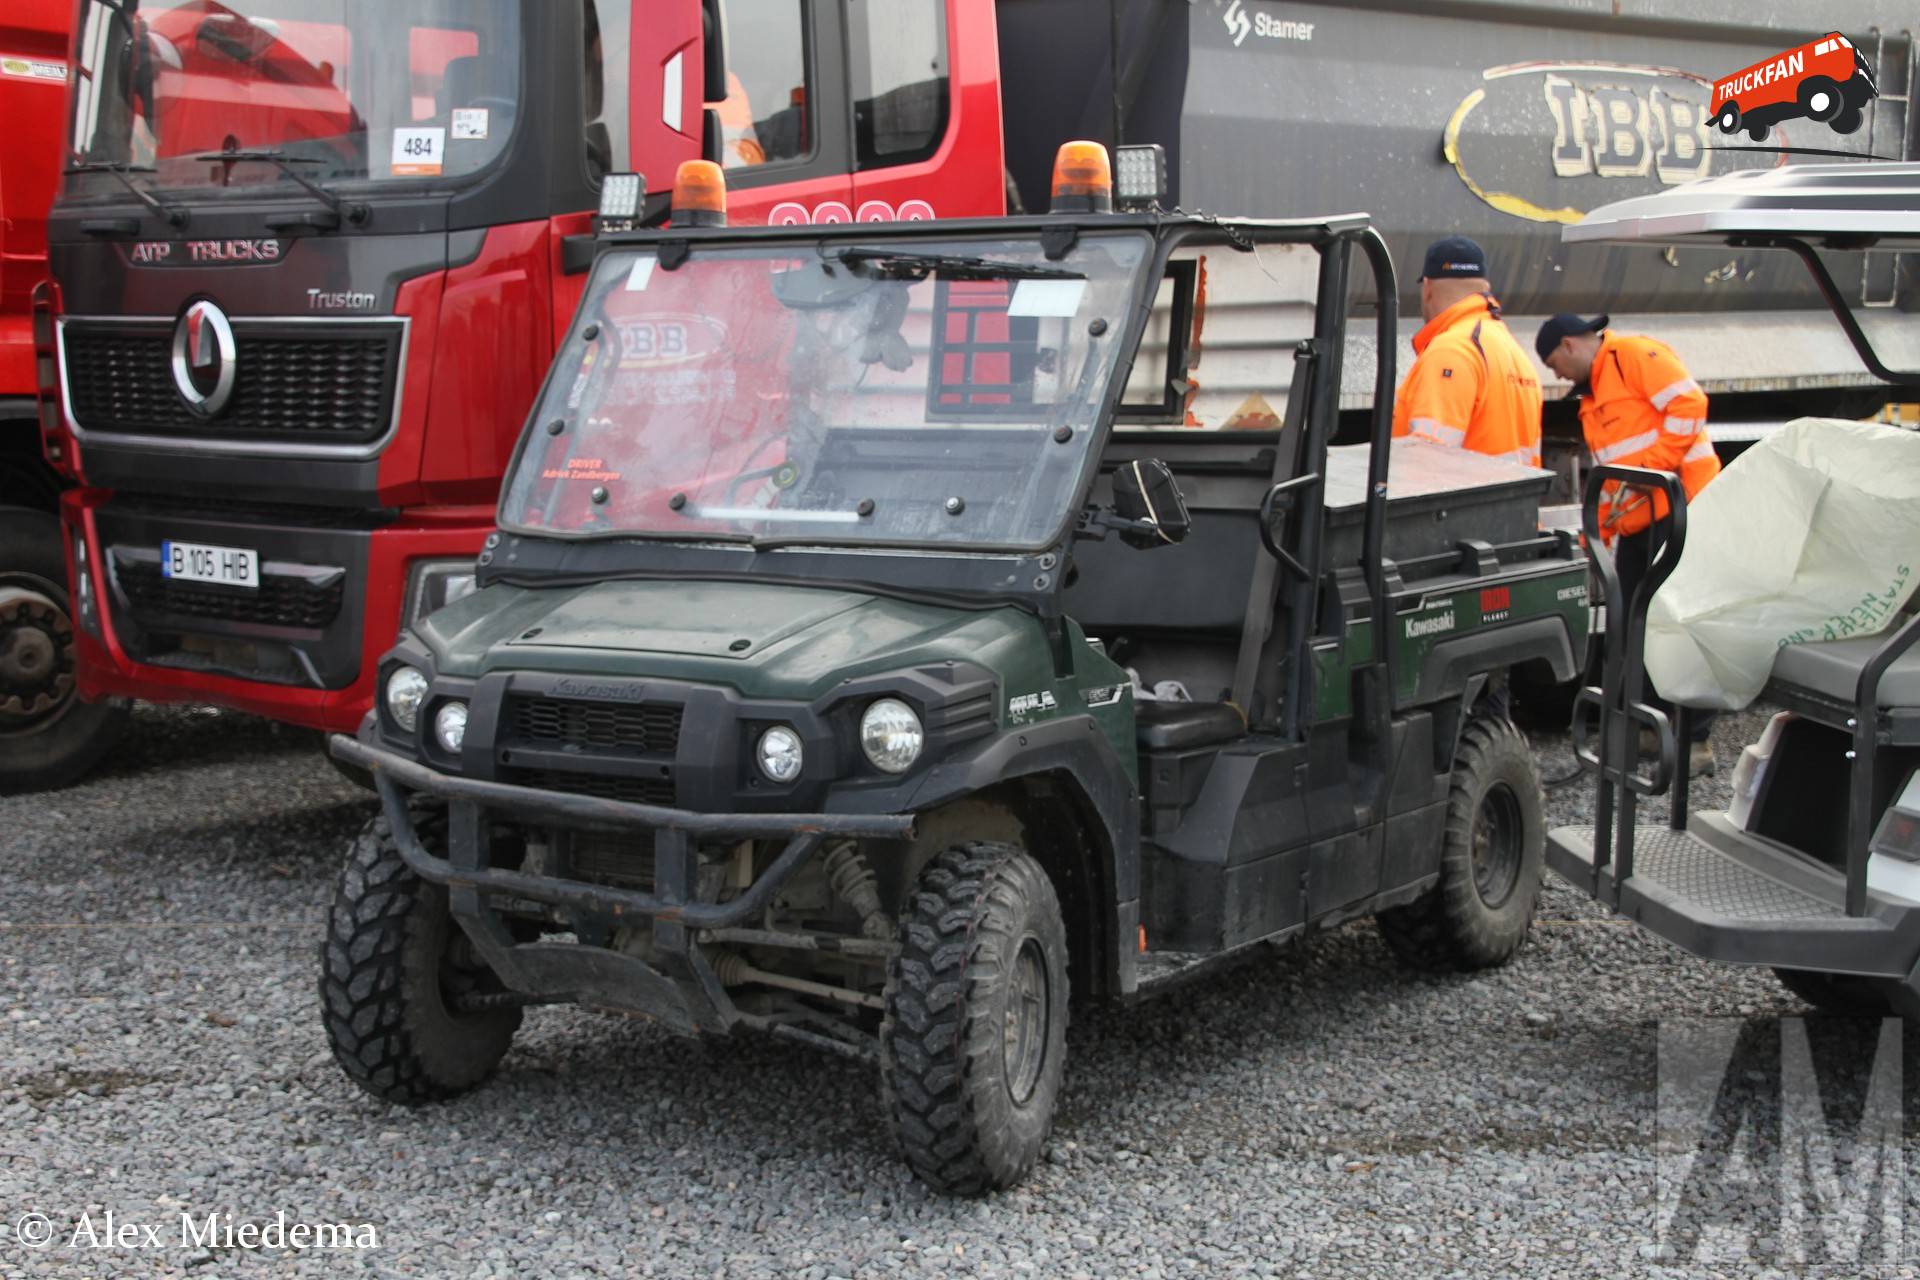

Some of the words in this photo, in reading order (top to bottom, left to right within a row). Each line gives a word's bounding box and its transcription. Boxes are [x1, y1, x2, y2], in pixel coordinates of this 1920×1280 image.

[1254, 12, 1315, 40] Stamer
[1546, 75, 1710, 180] IBB
[404, 137, 432, 155] 484
[131, 243, 170, 261] ATP
[187, 239, 280, 261] TRUCKS
[307, 288, 375, 309] Truston
[173, 547, 185, 574] B
[190, 549, 216, 577] 105
[223, 552, 249, 581] HIB
[1405, 610, 1455, 639] Kawasaki
